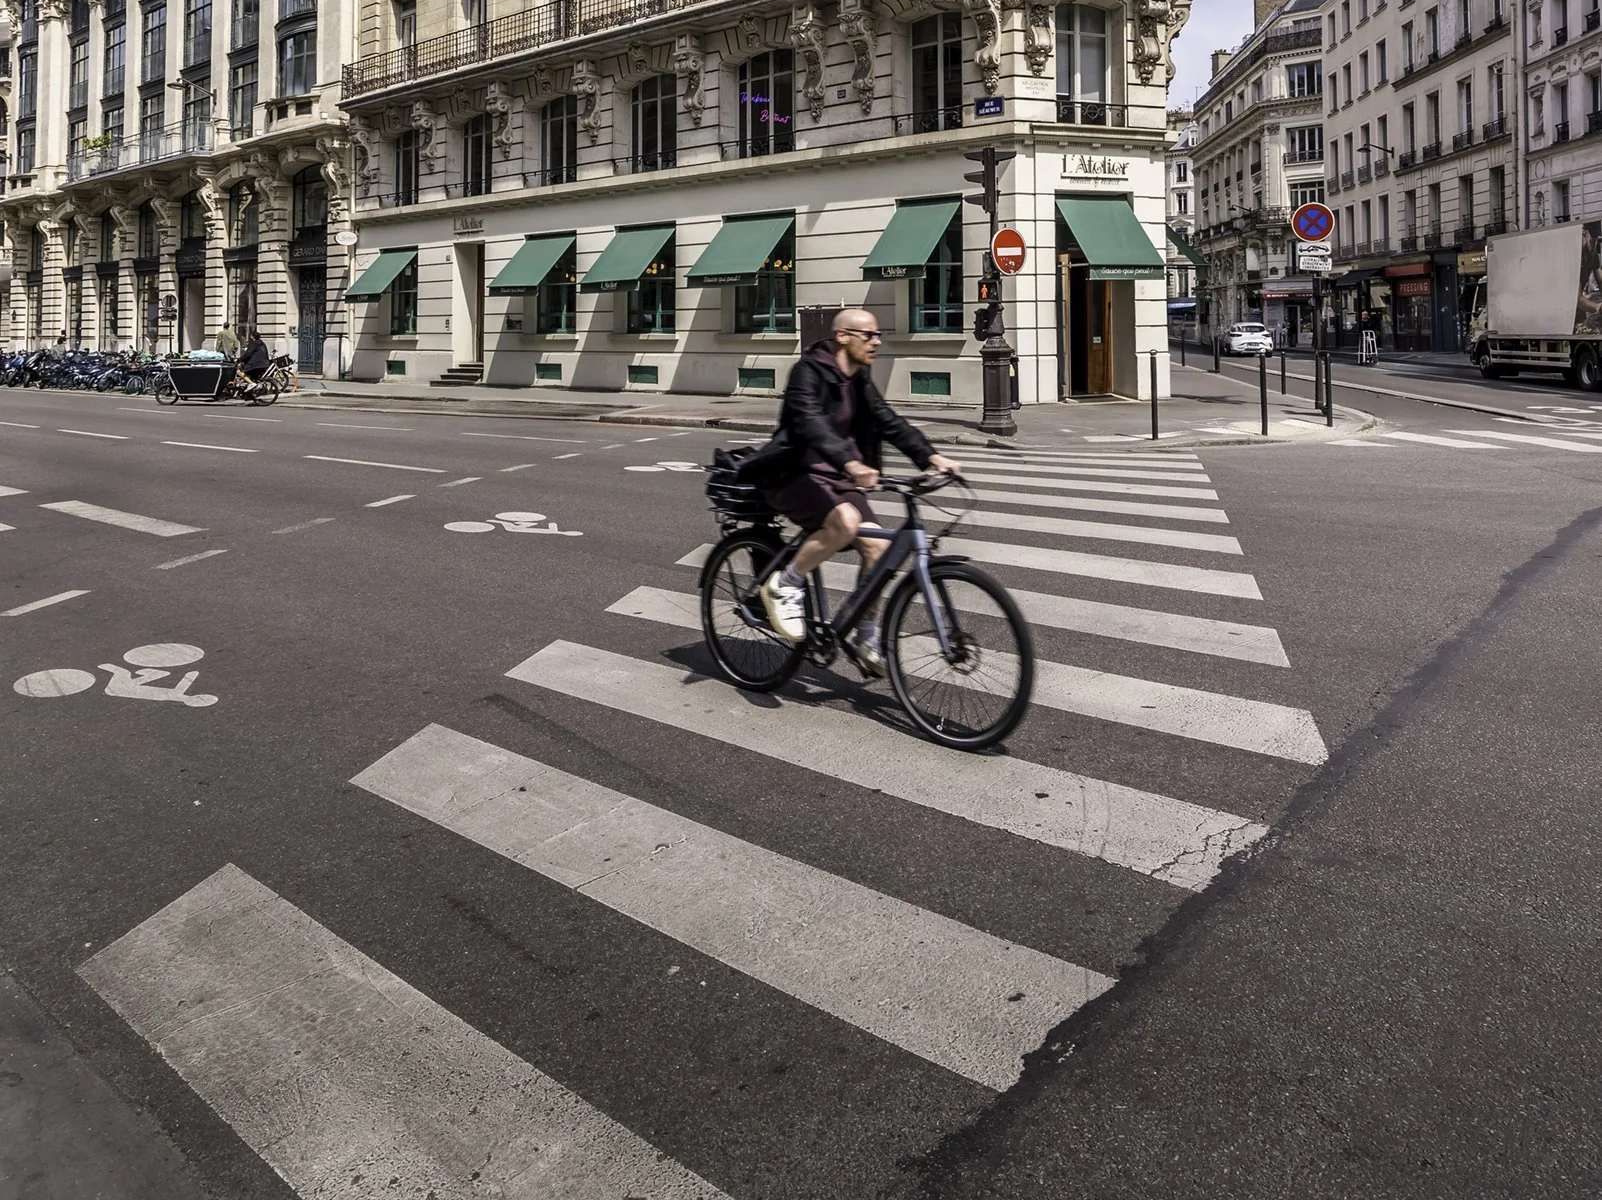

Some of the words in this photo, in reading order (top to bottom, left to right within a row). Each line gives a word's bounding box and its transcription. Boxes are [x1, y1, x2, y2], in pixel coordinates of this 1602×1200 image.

[1062, 154, 1130, 175] L'Atelier
[1122, 267, 1134, 276] qui
[1400, 282, 1428, 293] PRESSING
